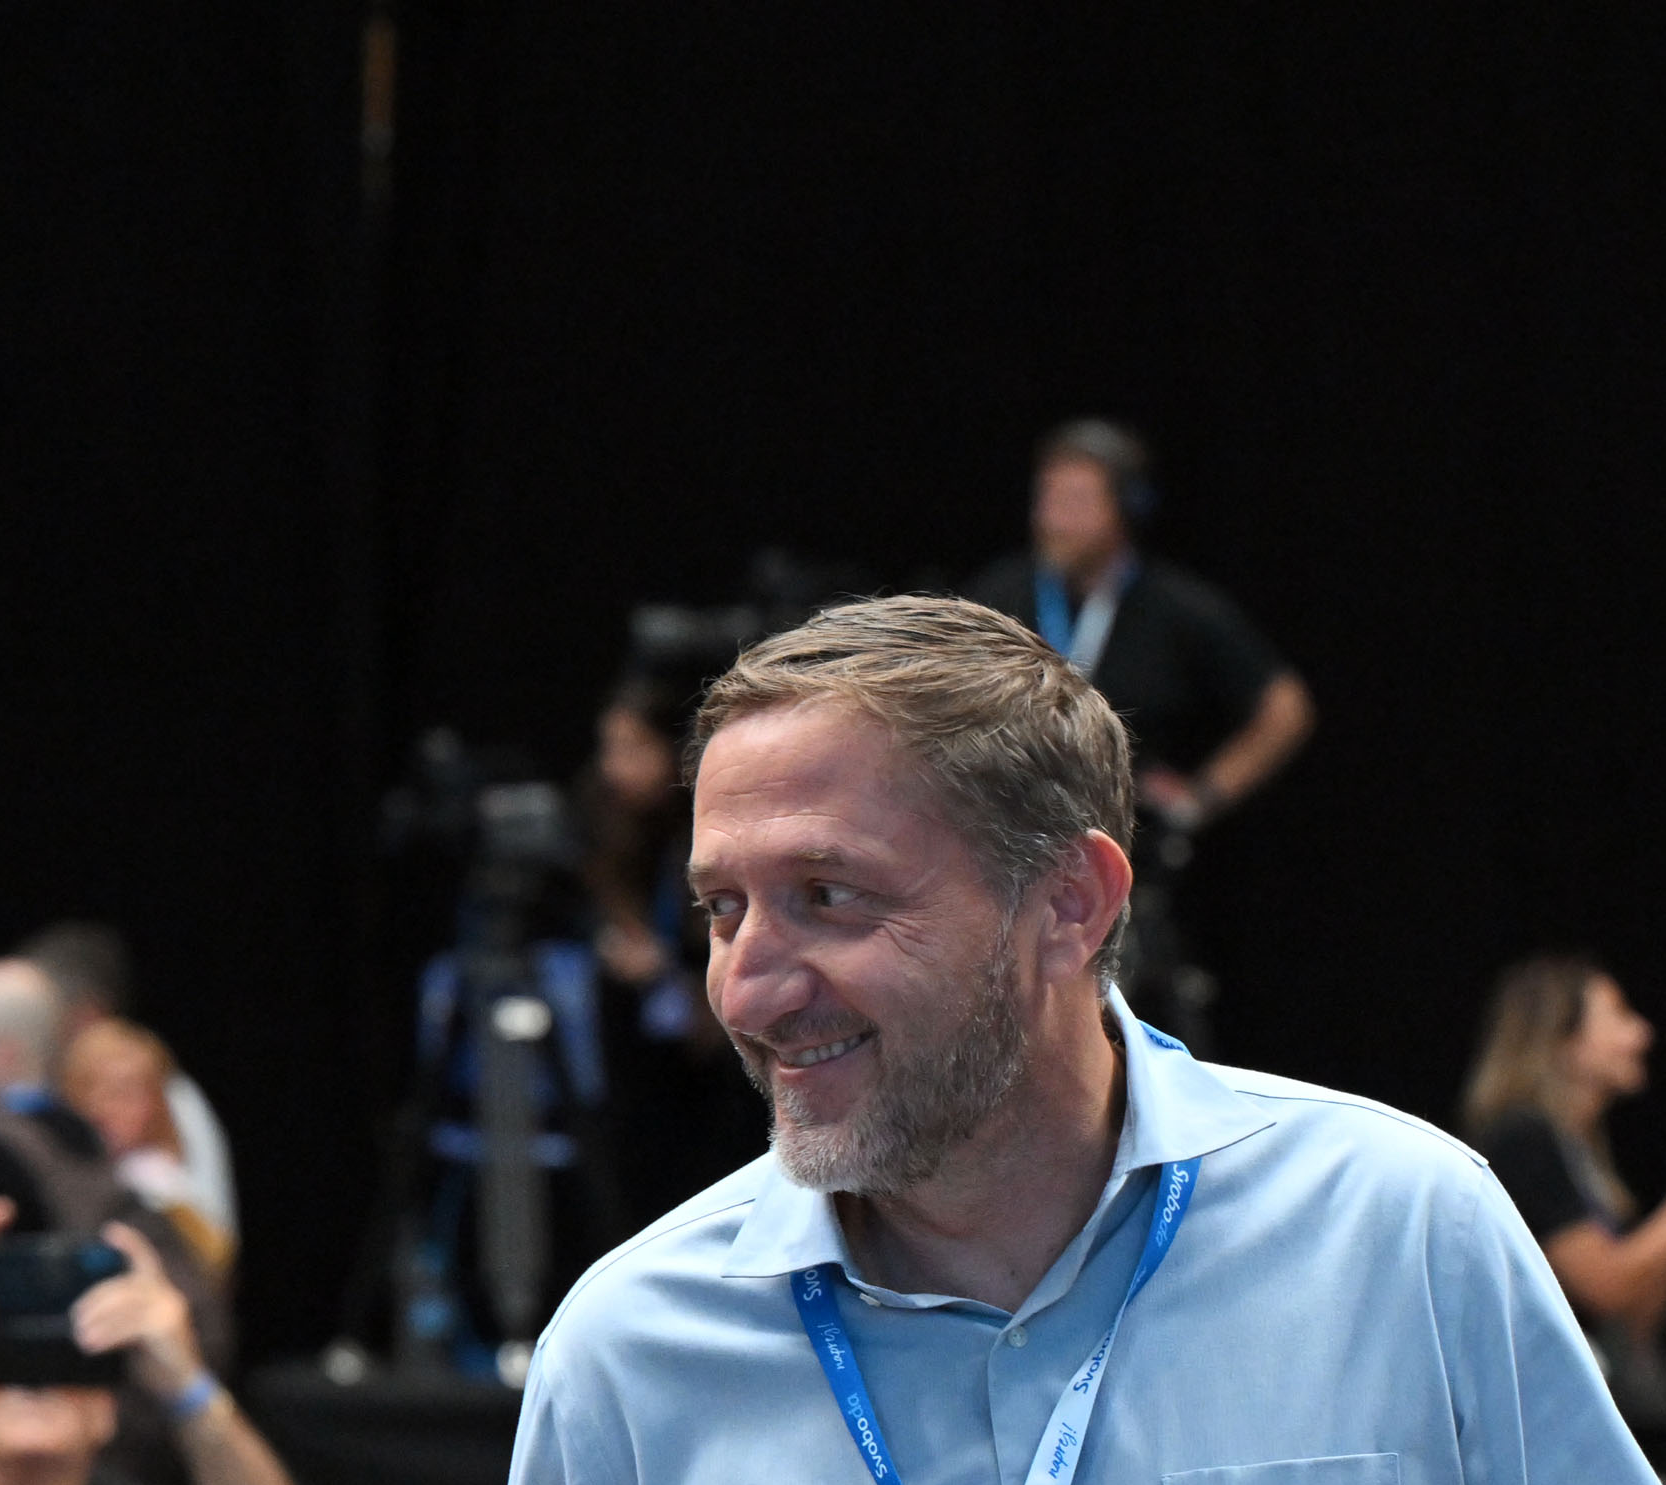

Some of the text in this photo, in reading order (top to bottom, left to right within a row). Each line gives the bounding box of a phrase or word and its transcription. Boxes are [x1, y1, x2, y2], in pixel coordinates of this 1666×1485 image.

[1155, 1163, 1190, 1248] Svoboda
[817, 1322, 845, 1370] naprej!
[1073, 1328, 1112, 1394] Svobo
[847, 1392, 888, 1479] Svoboda
[1048, 1422, 1078, 1479] naprej!
